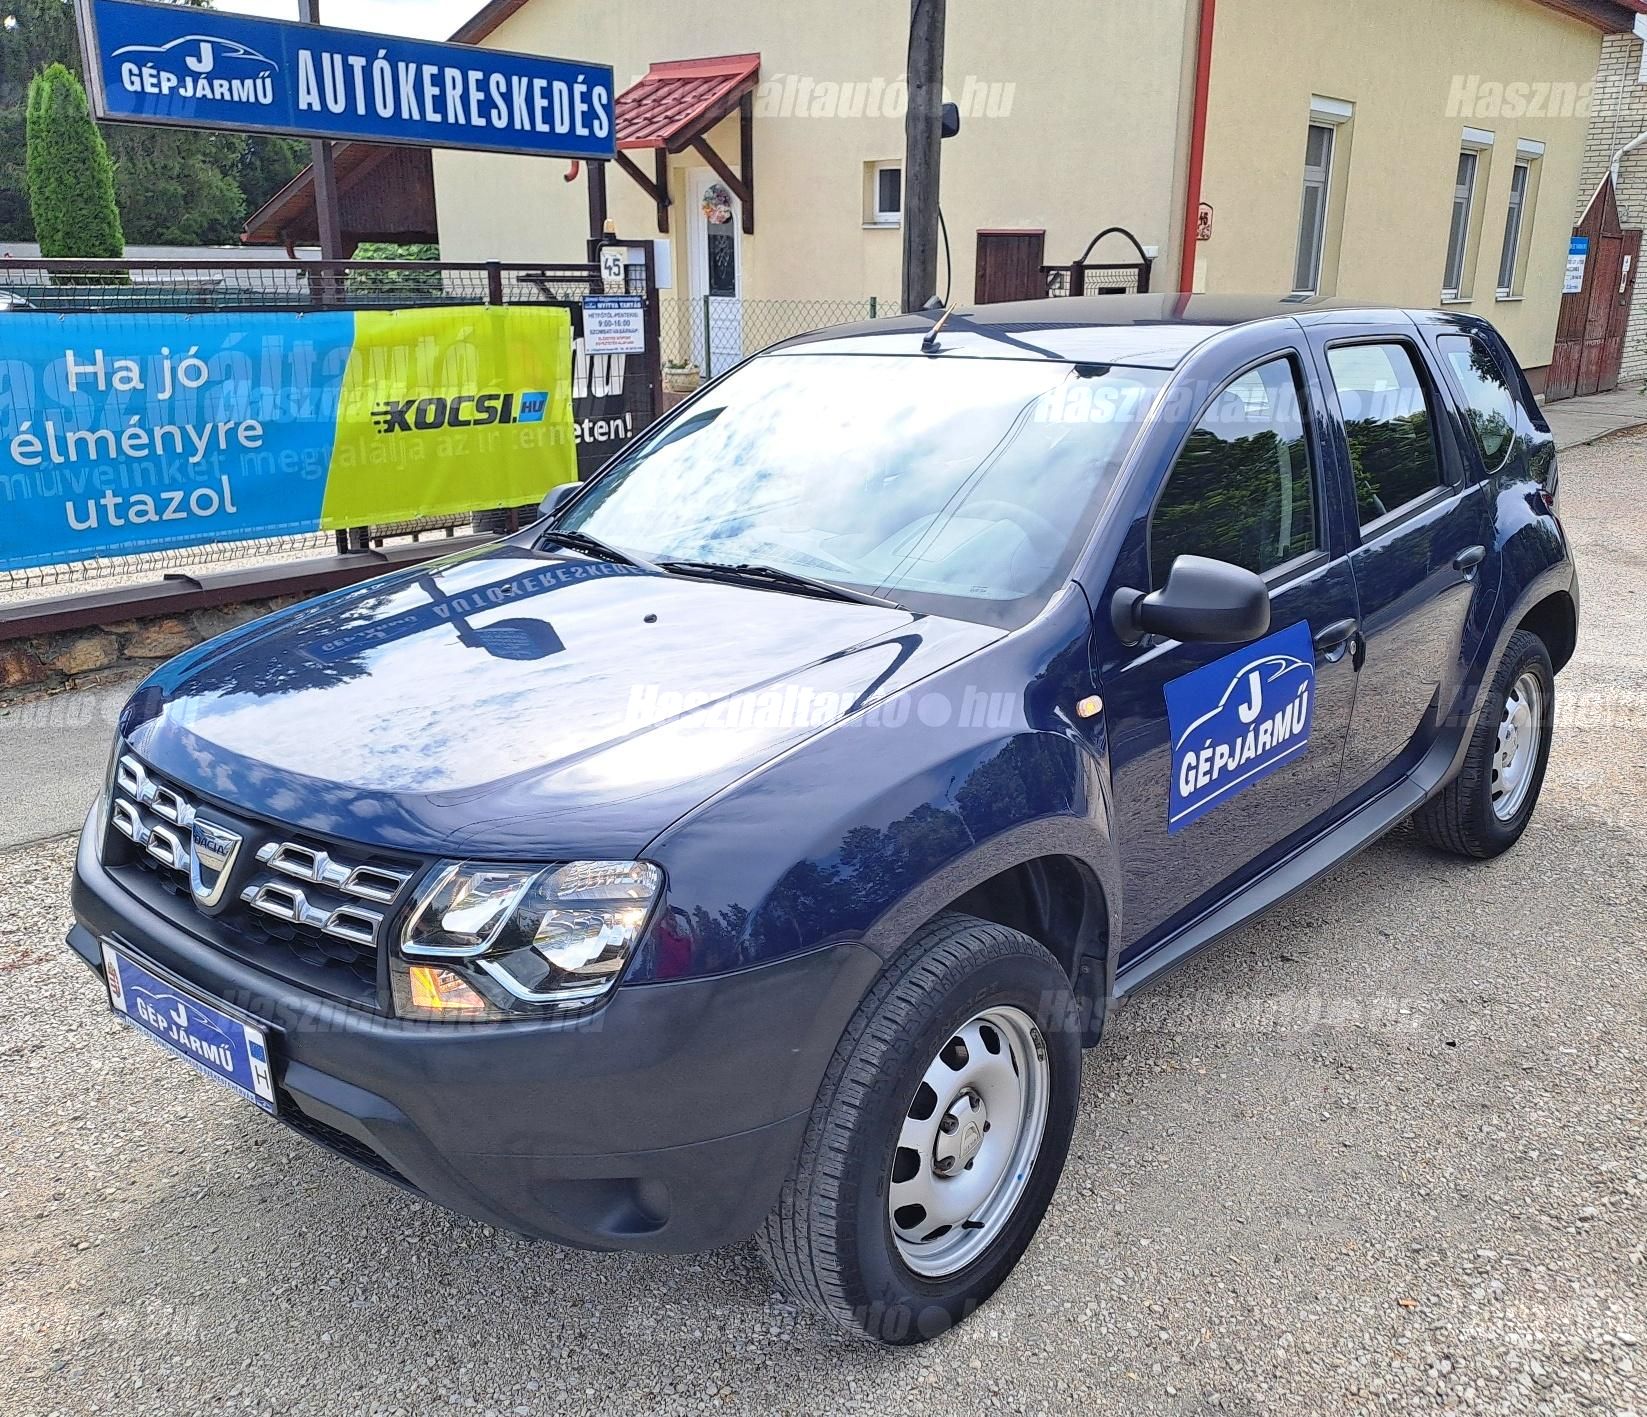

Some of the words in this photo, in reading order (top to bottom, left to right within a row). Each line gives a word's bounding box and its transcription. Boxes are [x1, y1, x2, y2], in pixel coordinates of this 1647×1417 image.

[184, 42, 214, 73] J
[121, 61, 274, 105] GÉPJÁRMŰ
[298, 48, 609, 139] AUTÓKERESKEDÉS
[604, 257, 621, 277] 45
[65, 348, 144, 392] Ha
[157, 345, 209, 400] jó
[10, 415, 264, 466] élményre
[65, 475, 237, 531] utazol
[1239, 671, 1263, 724] J
[1179, 682, 1310, 799] GÉPJÁRMŰ
[194, 835, 226, 855] DACIA
[169, 1002, 189, 1027] J
[254, 1065, 270, 1090] H
